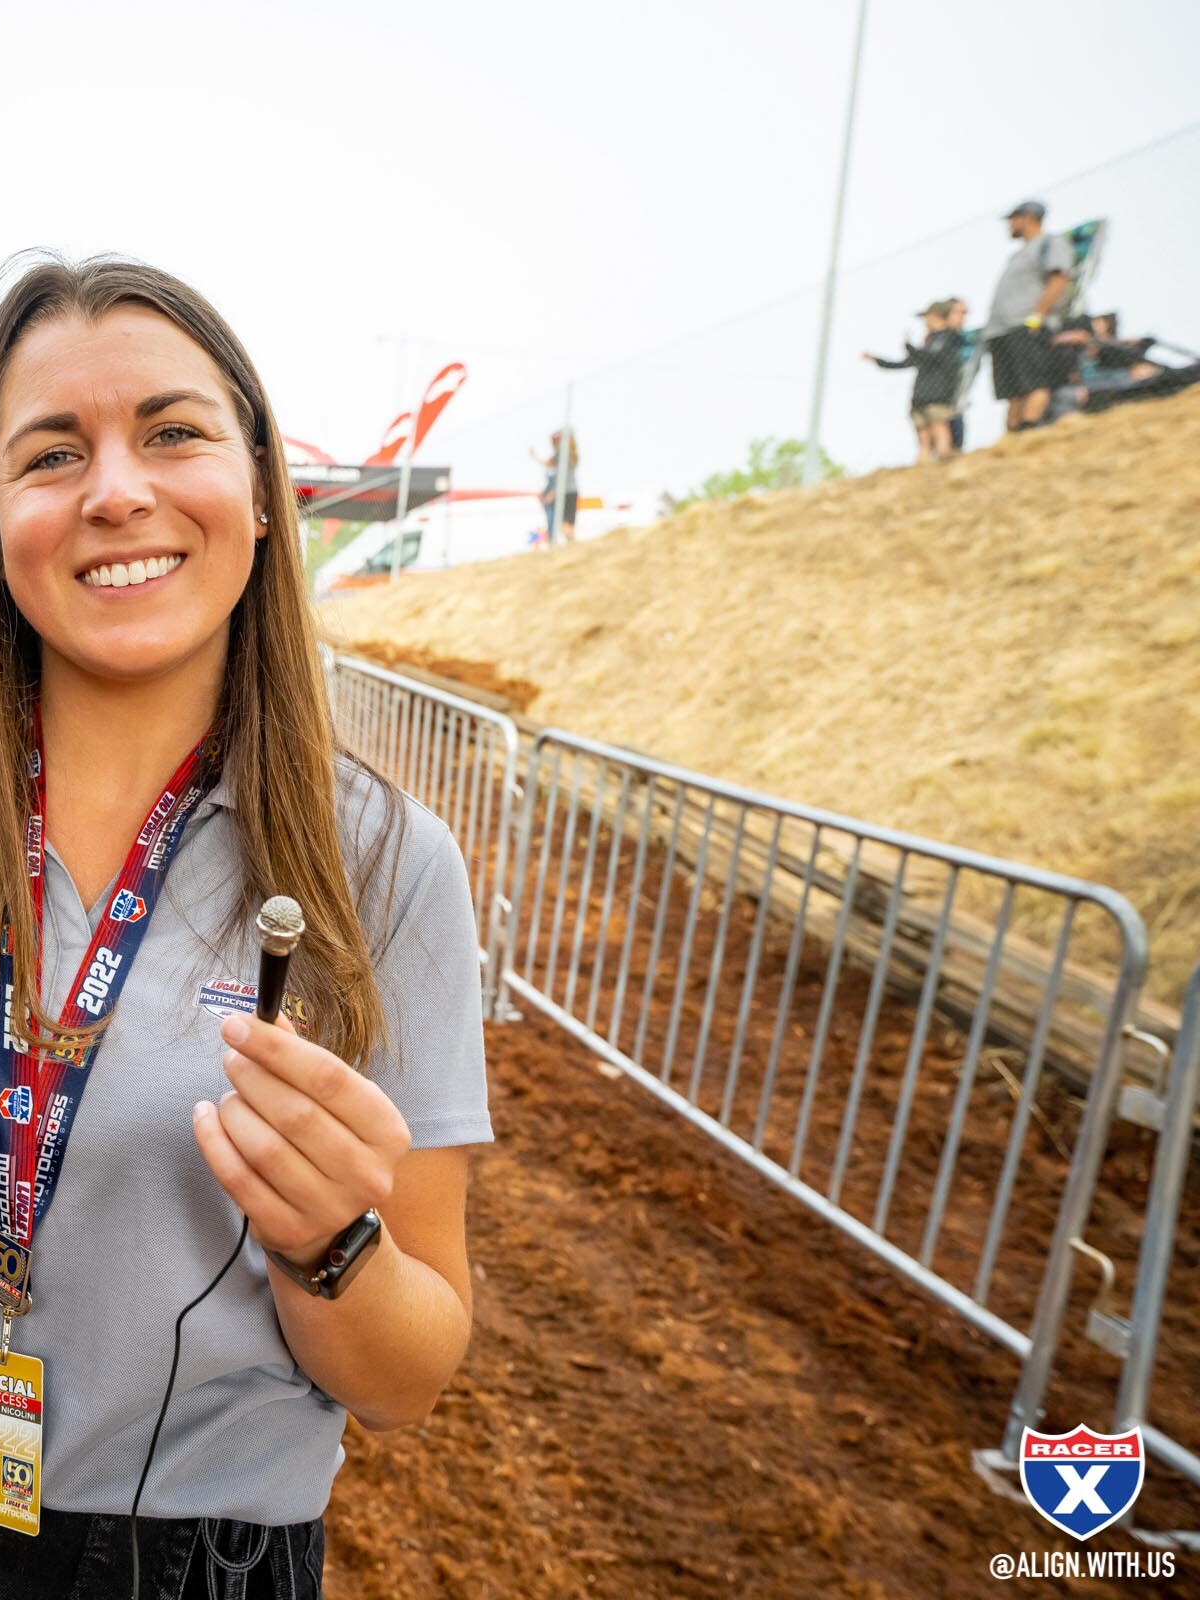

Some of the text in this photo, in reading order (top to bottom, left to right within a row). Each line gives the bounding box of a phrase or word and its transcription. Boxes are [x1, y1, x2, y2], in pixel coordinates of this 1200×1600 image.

[29, 817, 42, 854] LUCAS
[140, 793, 175, 844] LUCAS OIL
[76, 946, 123, 1016] 2022
[211, 981, 256, 996] LUCAS OIL
[200, 992, 257, 1010] MOTOCROS
[35, 1097, 75, 1217] CHAMPIONSHIP
[16, 1184, 30, 1231] LUCAS
[1, 1407, 36, 1420] NICOLINI
[6, 1460, 31, 1487] 50
